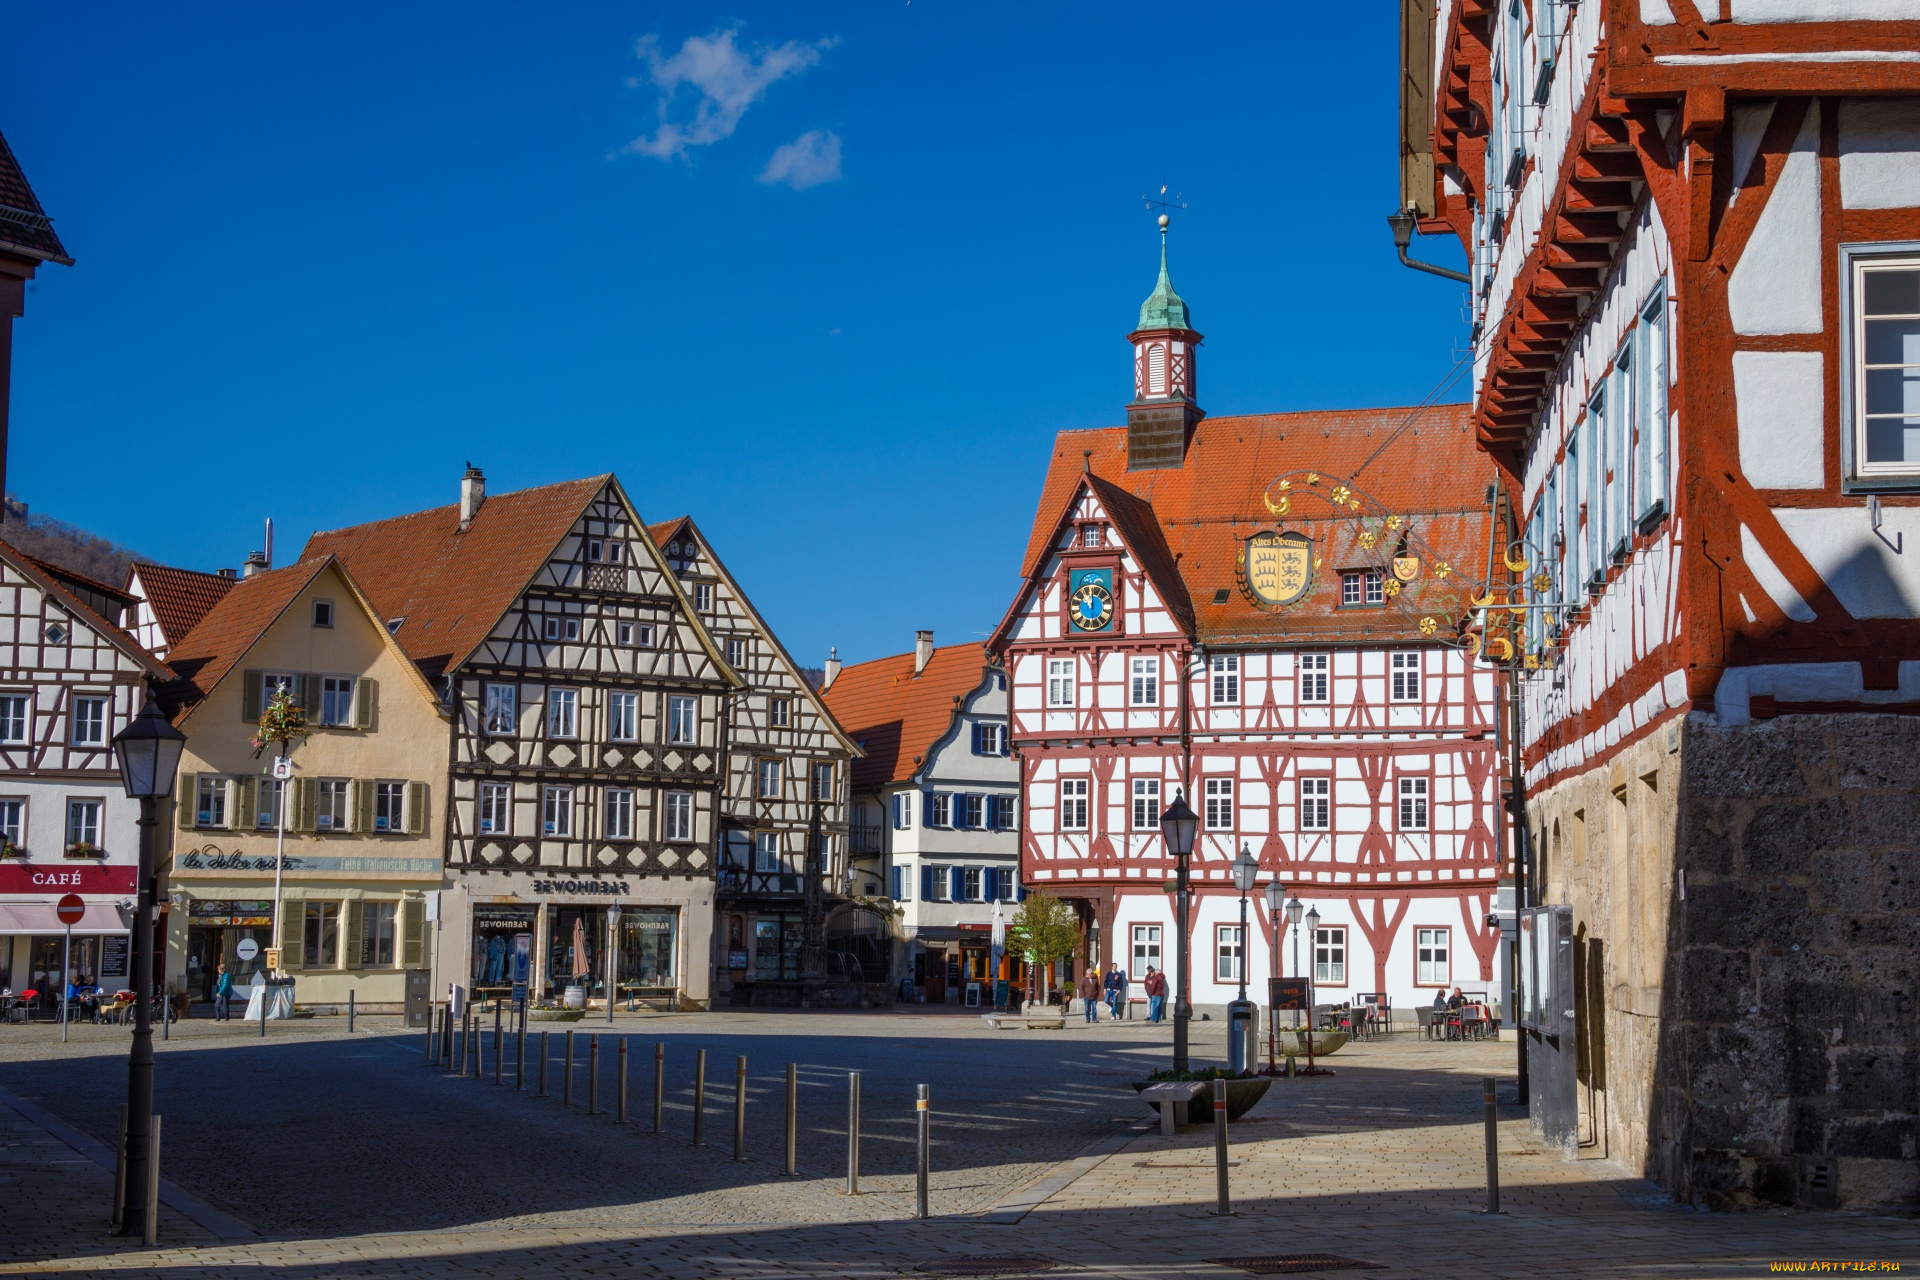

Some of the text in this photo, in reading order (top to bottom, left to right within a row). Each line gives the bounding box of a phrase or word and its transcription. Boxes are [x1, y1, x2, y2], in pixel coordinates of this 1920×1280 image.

[1250, 535, 1309, 549] Altes Oberamt
[341, 858, 433, 872] Feine italienische Küche
[32, 869, 82, 885] CAFÉ
[533, 880, 629, 894] BEWOHNBAR
[479, 920, 528, 929] BEWOHNBAR
[624, 922, 670, 930] BEWOHNBAR
